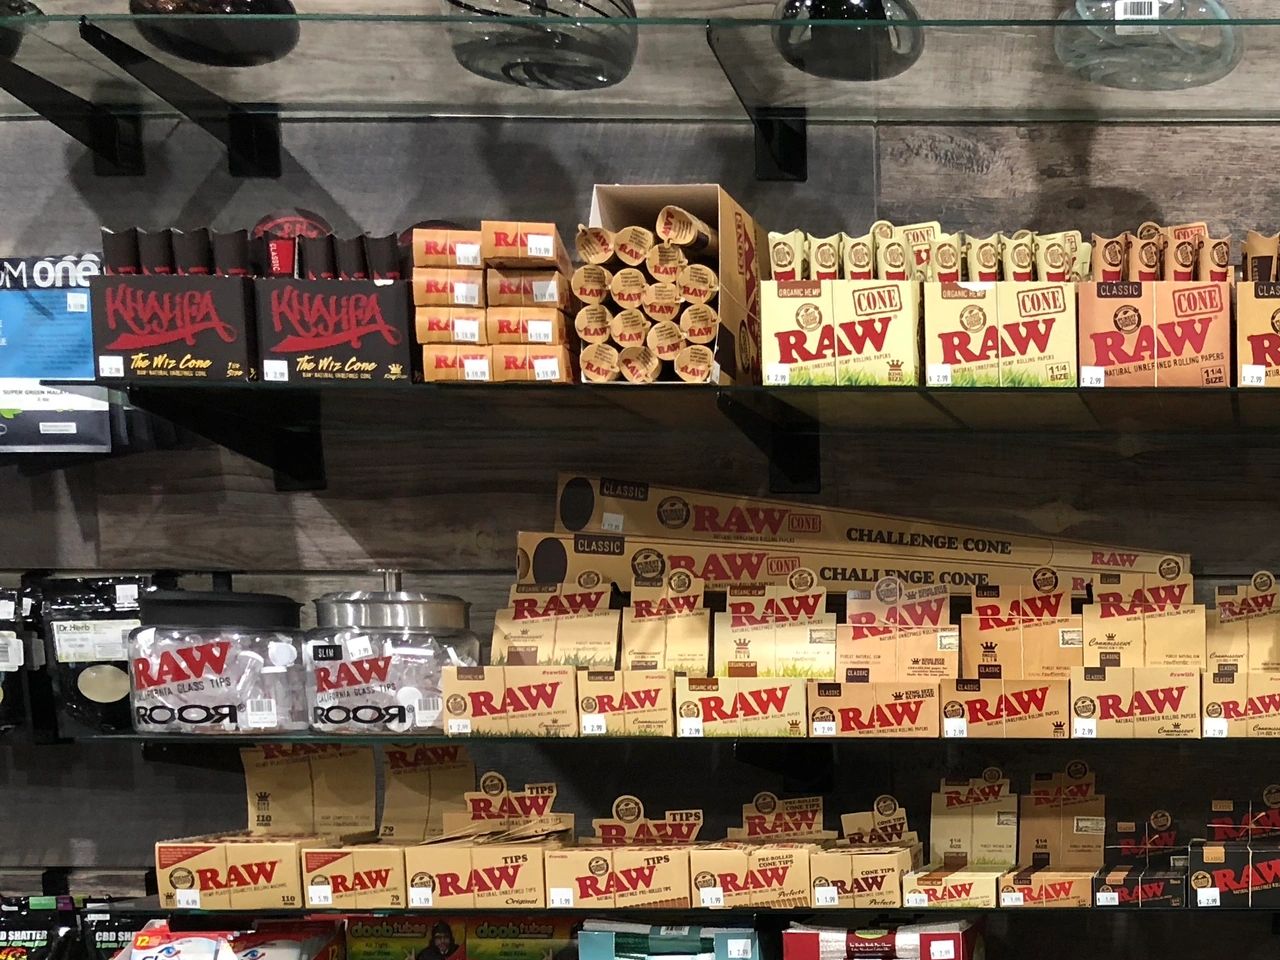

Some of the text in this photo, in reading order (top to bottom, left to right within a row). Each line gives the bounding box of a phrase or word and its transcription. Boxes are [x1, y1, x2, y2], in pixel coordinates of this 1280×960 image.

[654, 266, 678, 277] RAW
[779, 289, 803, 299] ORGANIC
[857, 288, 899, 310] CONE
[1100, 283, 1139, 297] CLASSIC
[775, 318, 892, 364] RAW
[1090, 318, 1213, 366] RAW
[131, 353, 150, 369] The
[179, 353, 213, 369] Cone
[1173, 356, 1199, 368] ROLLING
[1201, 353, 1225, 363] PAPERS
[604, 482, 646, 499] CLASSIC
[693, 506, 818, 536] RAW CONE
[846, 528, 1012, 554] CHALLENGE CONE
[1091, 552, 1140, 568] RAW
[512, 591, 604, 621] RAW
[135, 641, 231, 690] RAW
[471, 682, 560, 717] RAW
[1096, 687, 1188, 719] RAW
[527, 786, 554, 796] TIPS
[470, 796, 551, 821] RAW
[196, 861, 279, 891] RAW
[9, 930, 48, 941] SHATTER
